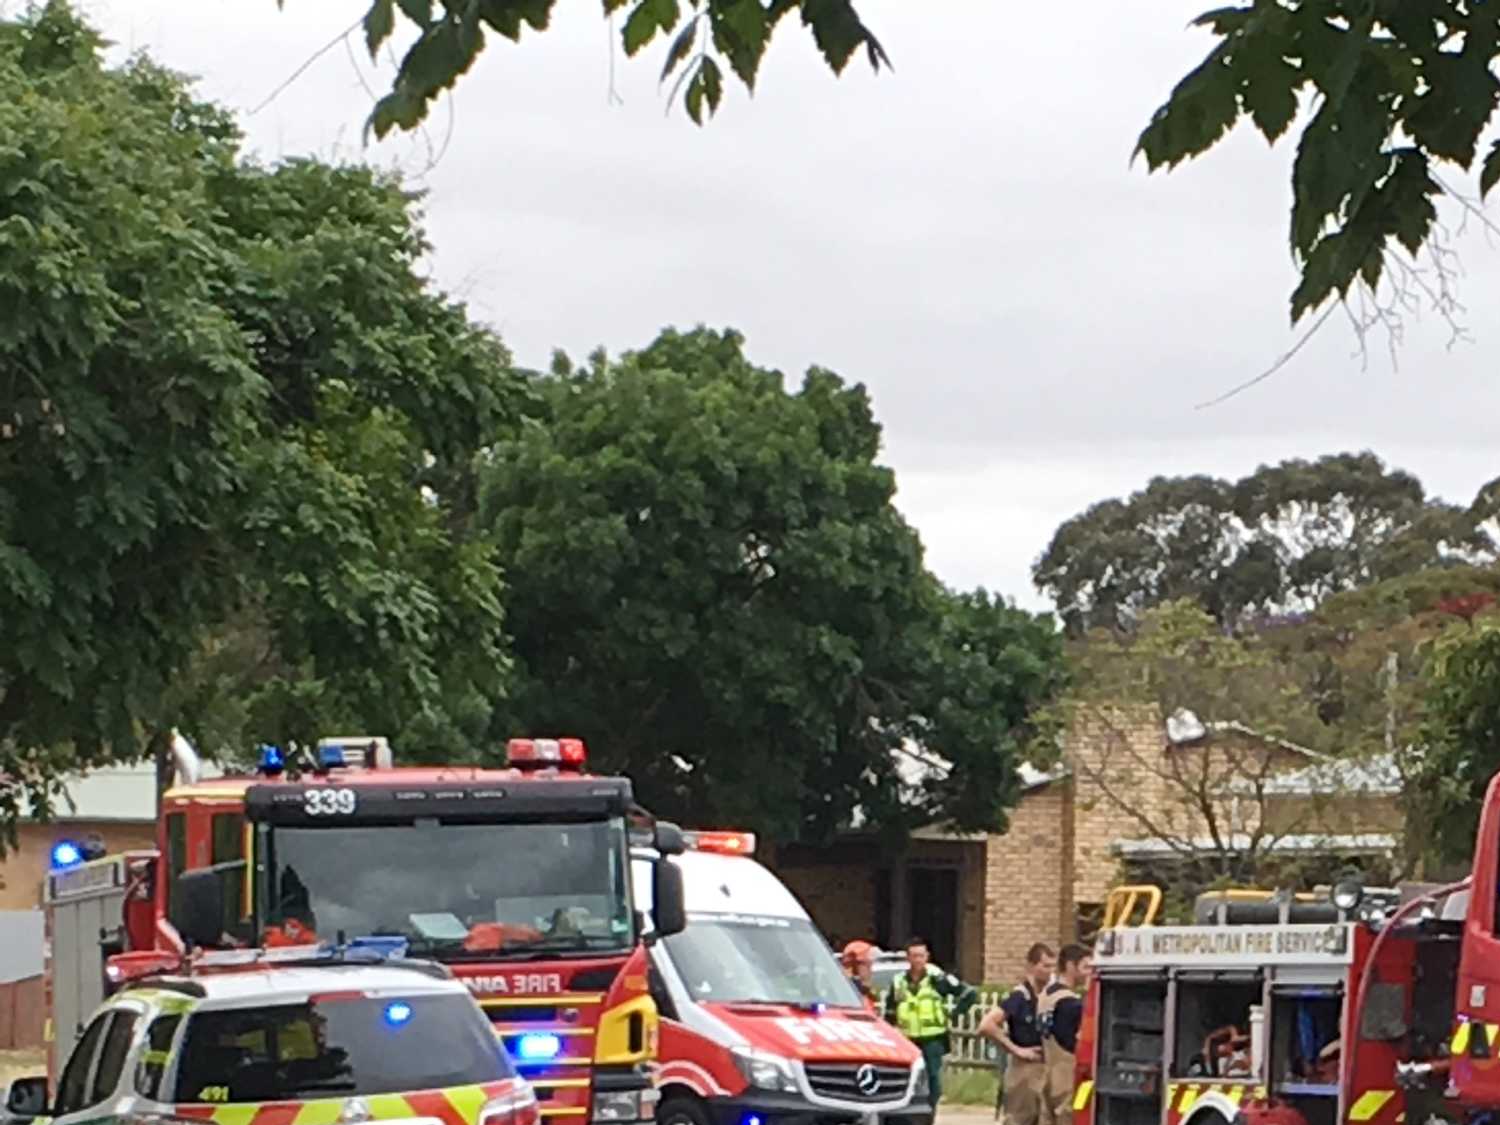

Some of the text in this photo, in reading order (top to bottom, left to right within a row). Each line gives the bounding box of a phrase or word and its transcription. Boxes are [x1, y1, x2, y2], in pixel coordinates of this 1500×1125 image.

[304, 788, 356, 815] 339
[1152, 933, 1243, 954] METROPOLITAN
[1246, 932, 1273, 953] FIRE
[775, 1017, 898, 1048] FIRE
